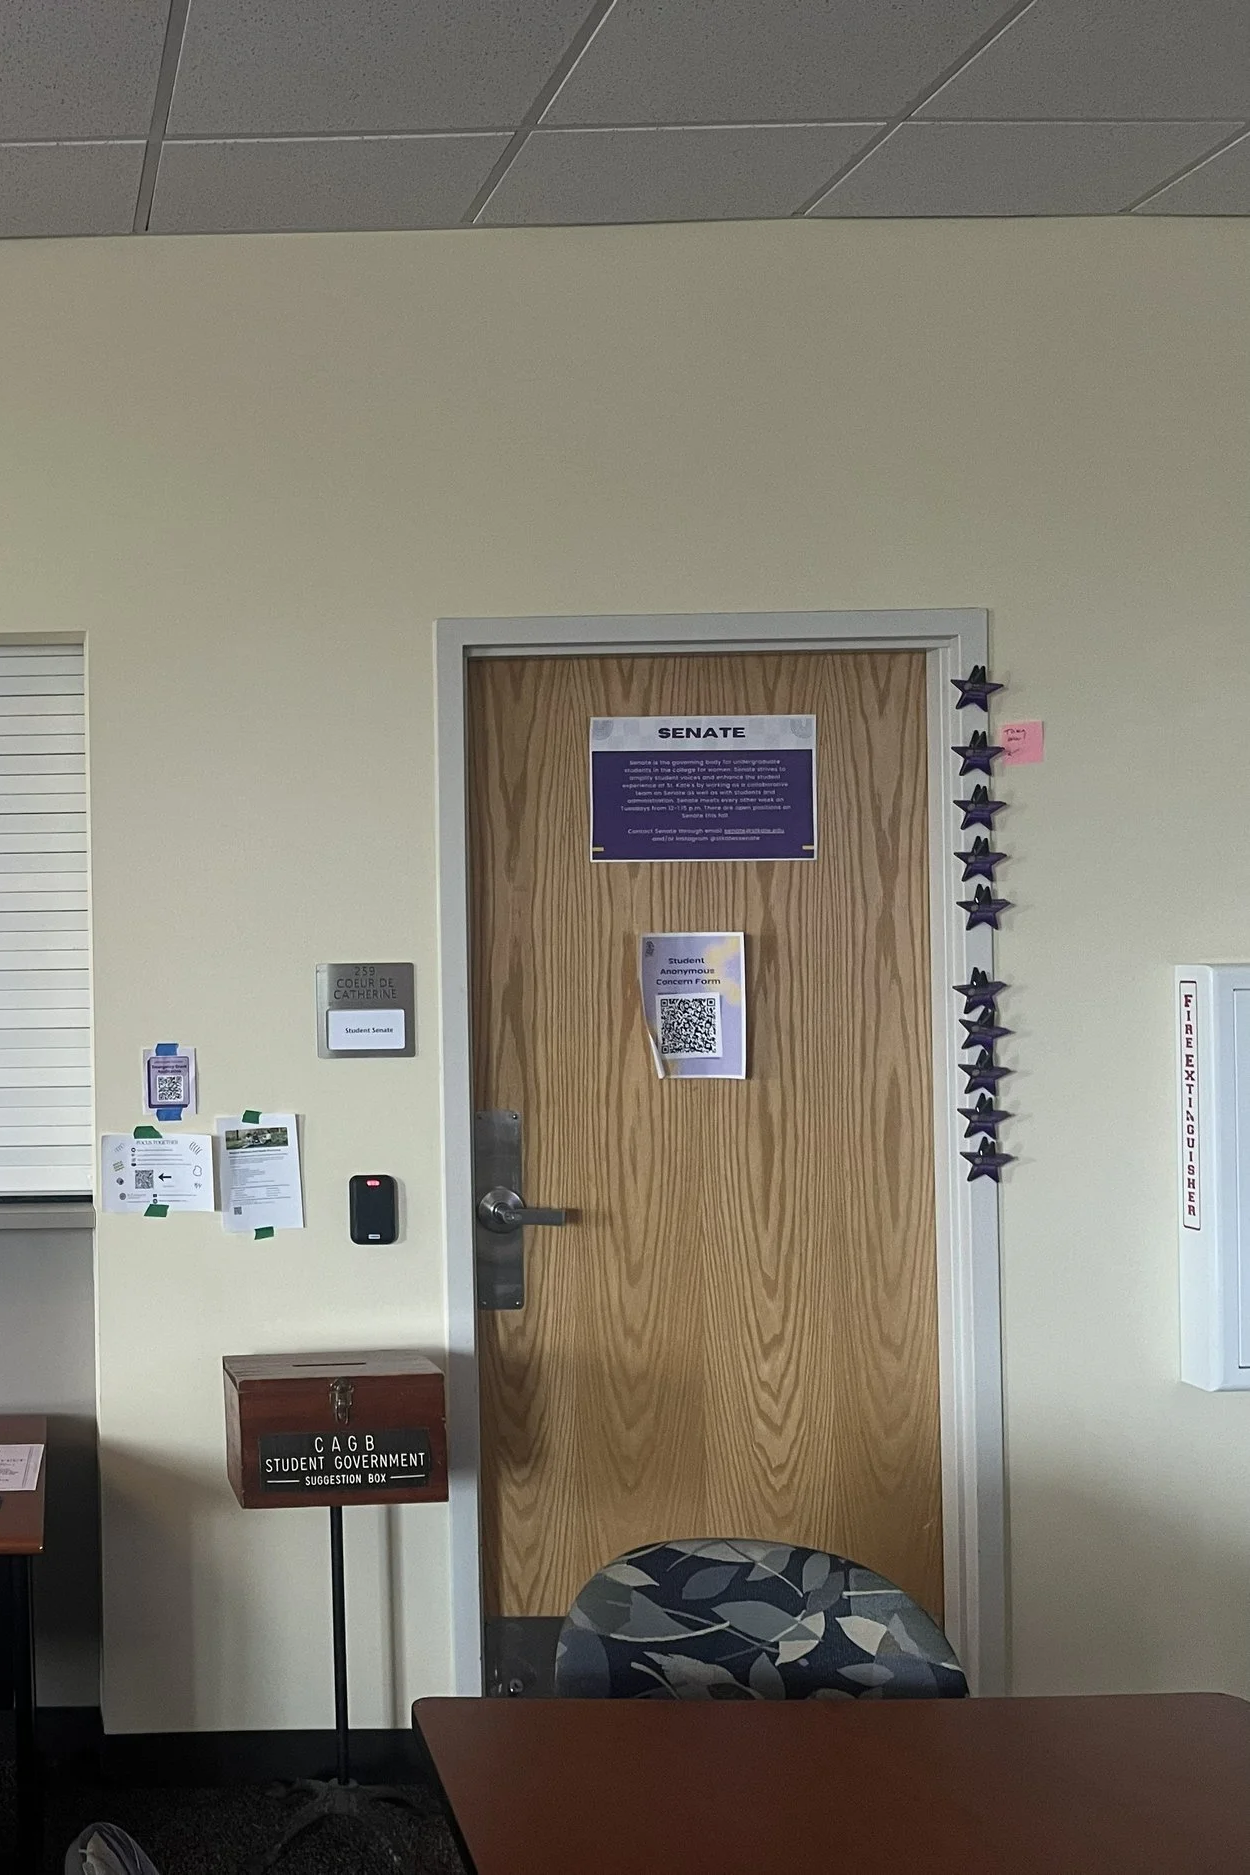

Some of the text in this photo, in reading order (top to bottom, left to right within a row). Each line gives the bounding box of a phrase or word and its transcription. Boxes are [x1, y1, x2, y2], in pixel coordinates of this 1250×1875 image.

[658, 727, 746, 739] SENATE
[660, 968, 715, 976] Anonymous
[336, 978, 394, 988] COEUR DE
[334, 989, 397, 1000] CATHERINE
[1184, 994, 1197, 1217] FIRE EXTINGUISHER
[265, 1452, 425, 1473] STUDENT GOVERNMENT
[305, 1473, 387, 1486] SUGGESTION BOX
